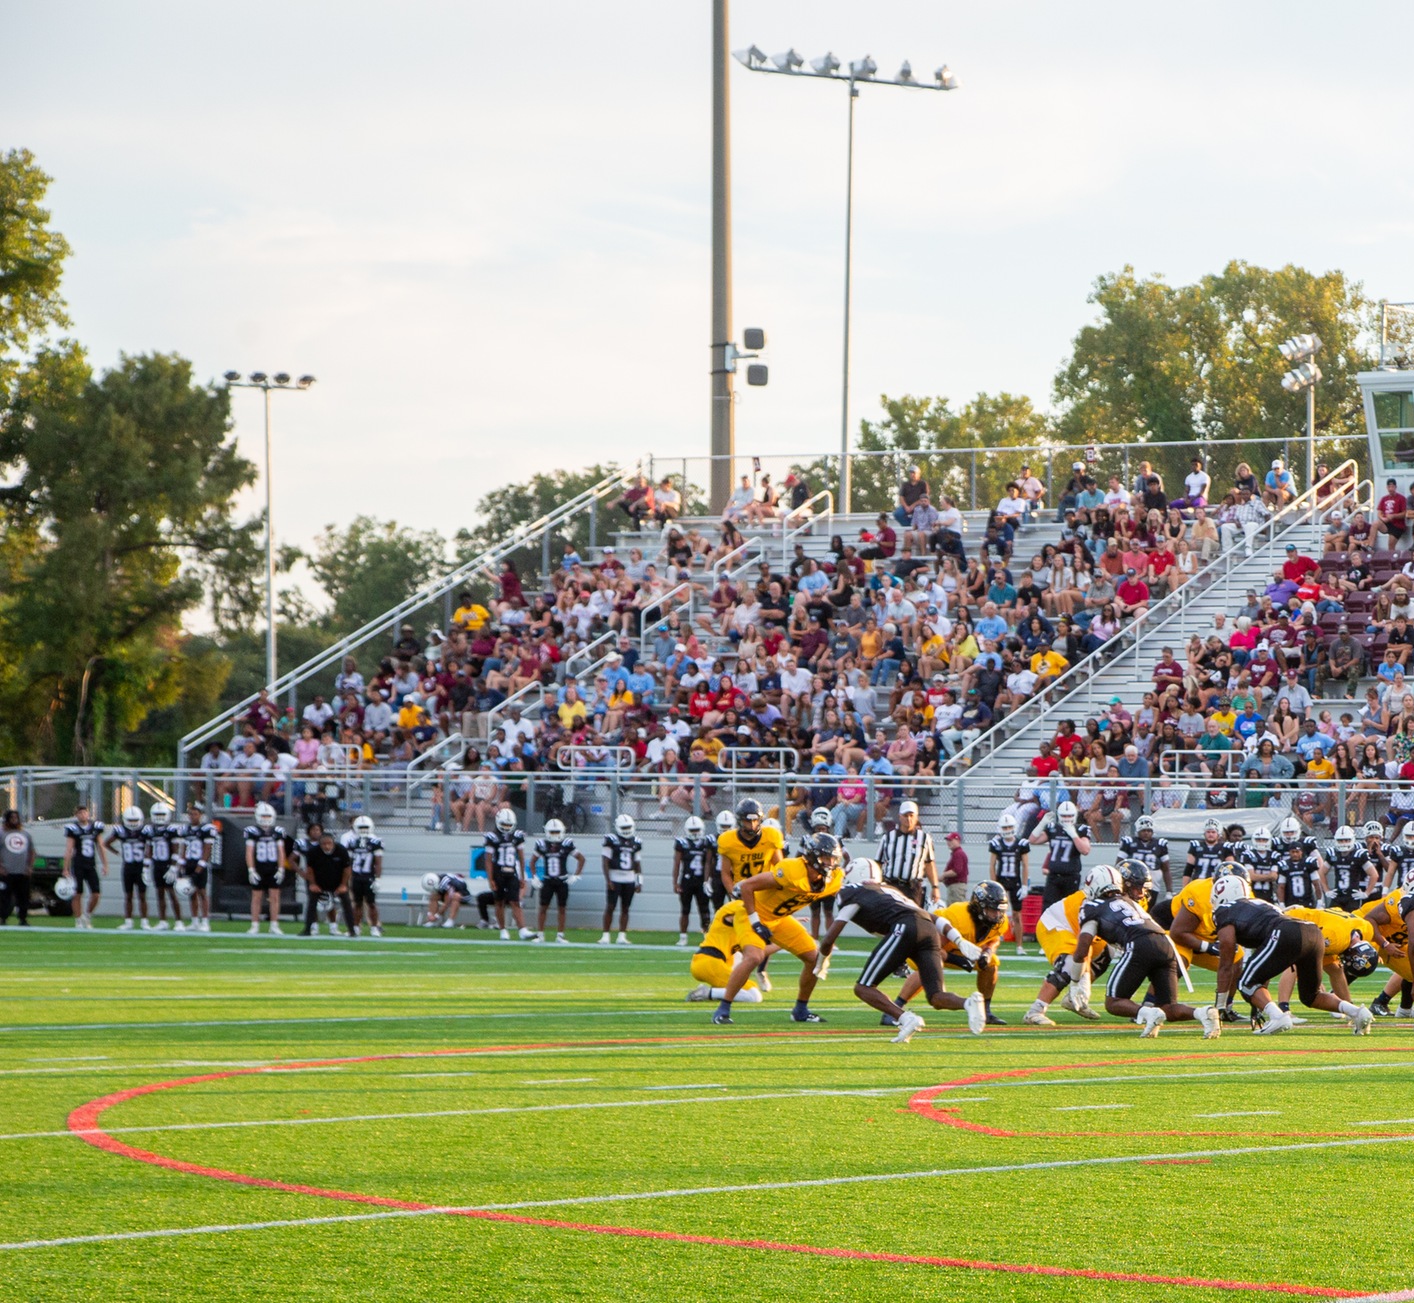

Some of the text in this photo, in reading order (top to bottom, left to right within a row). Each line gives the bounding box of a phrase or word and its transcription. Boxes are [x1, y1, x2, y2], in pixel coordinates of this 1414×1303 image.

[741, 852, 764, 862] ETBU
[1050, 839, 1074, 863] 77
[689, 854, 703, 876] 4
[741, 860, 765, 878] 47
[1292, 875, 1306, 898] 8
[1338, 868, 1351, 890] 3
